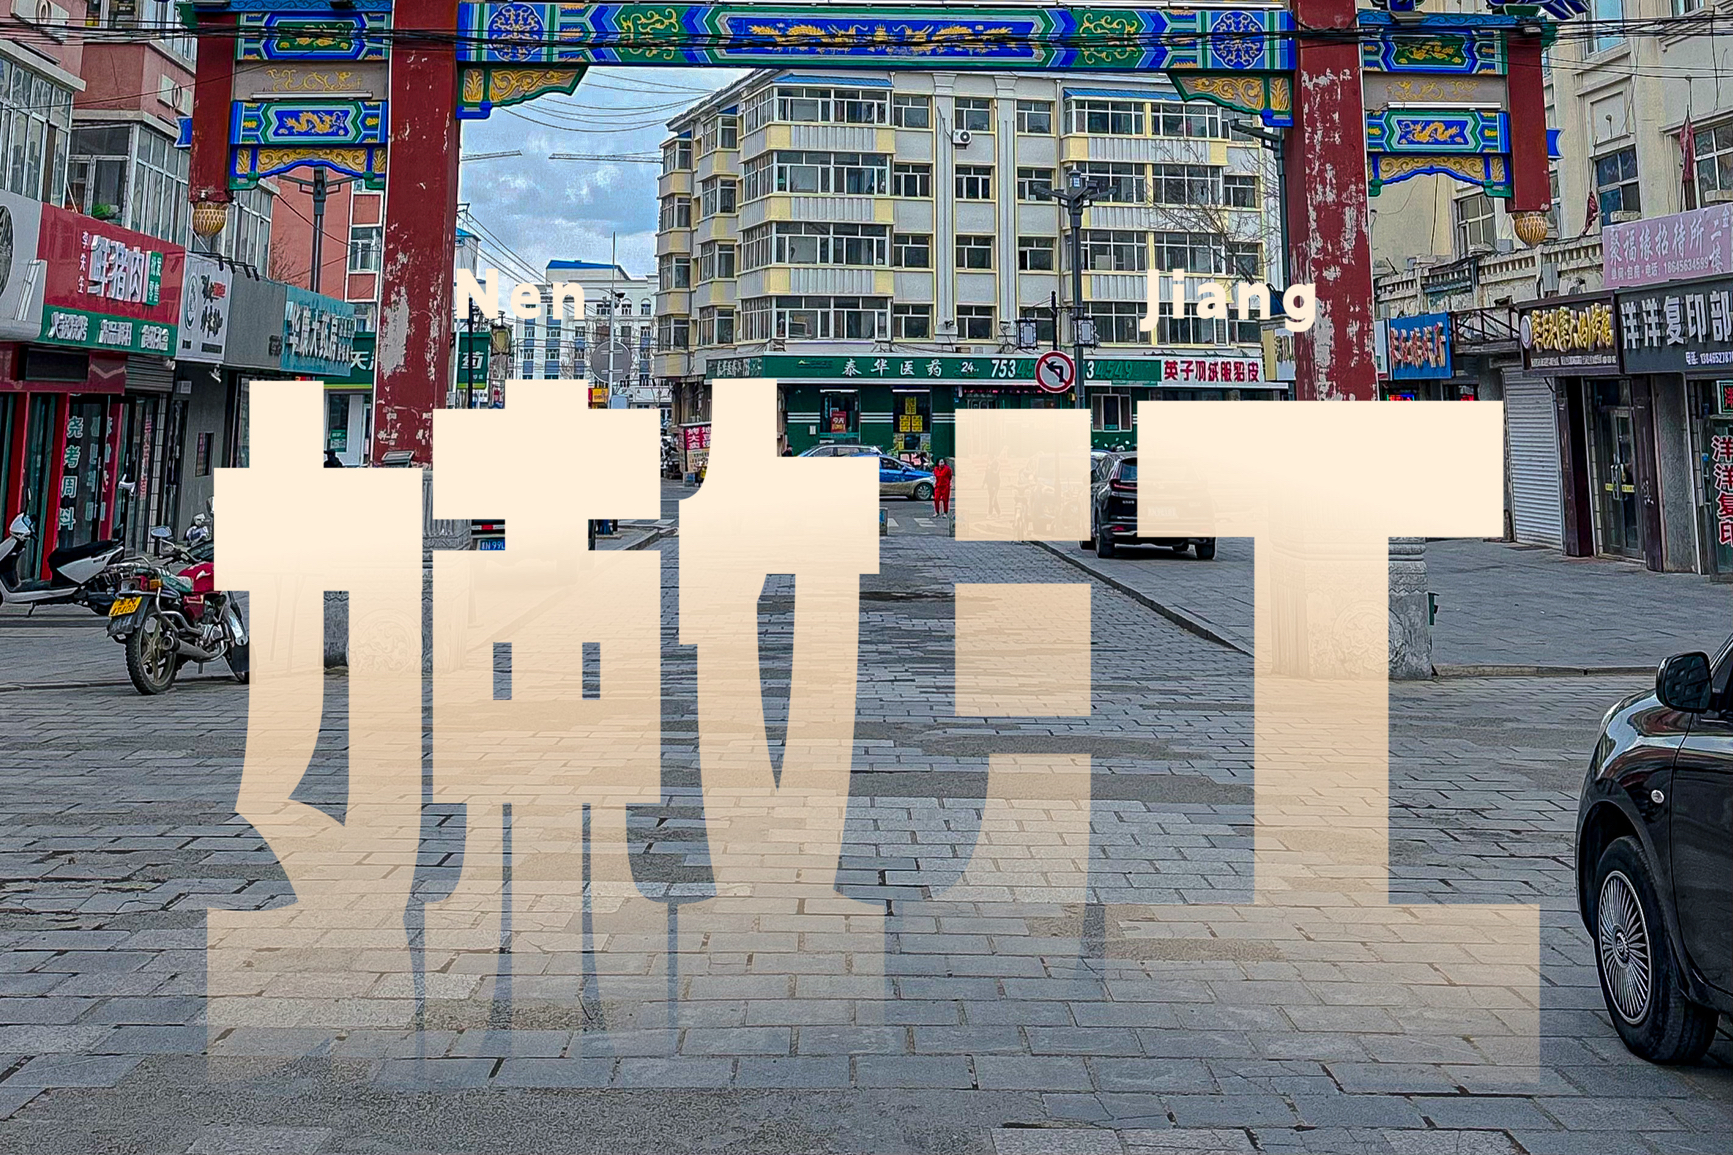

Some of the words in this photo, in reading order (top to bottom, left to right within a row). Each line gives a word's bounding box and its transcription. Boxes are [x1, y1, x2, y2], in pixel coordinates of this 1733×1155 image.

[1620, 289, 1733, 350] 洋洋复印部
[841, 357, 943, 378] 泰华医药
